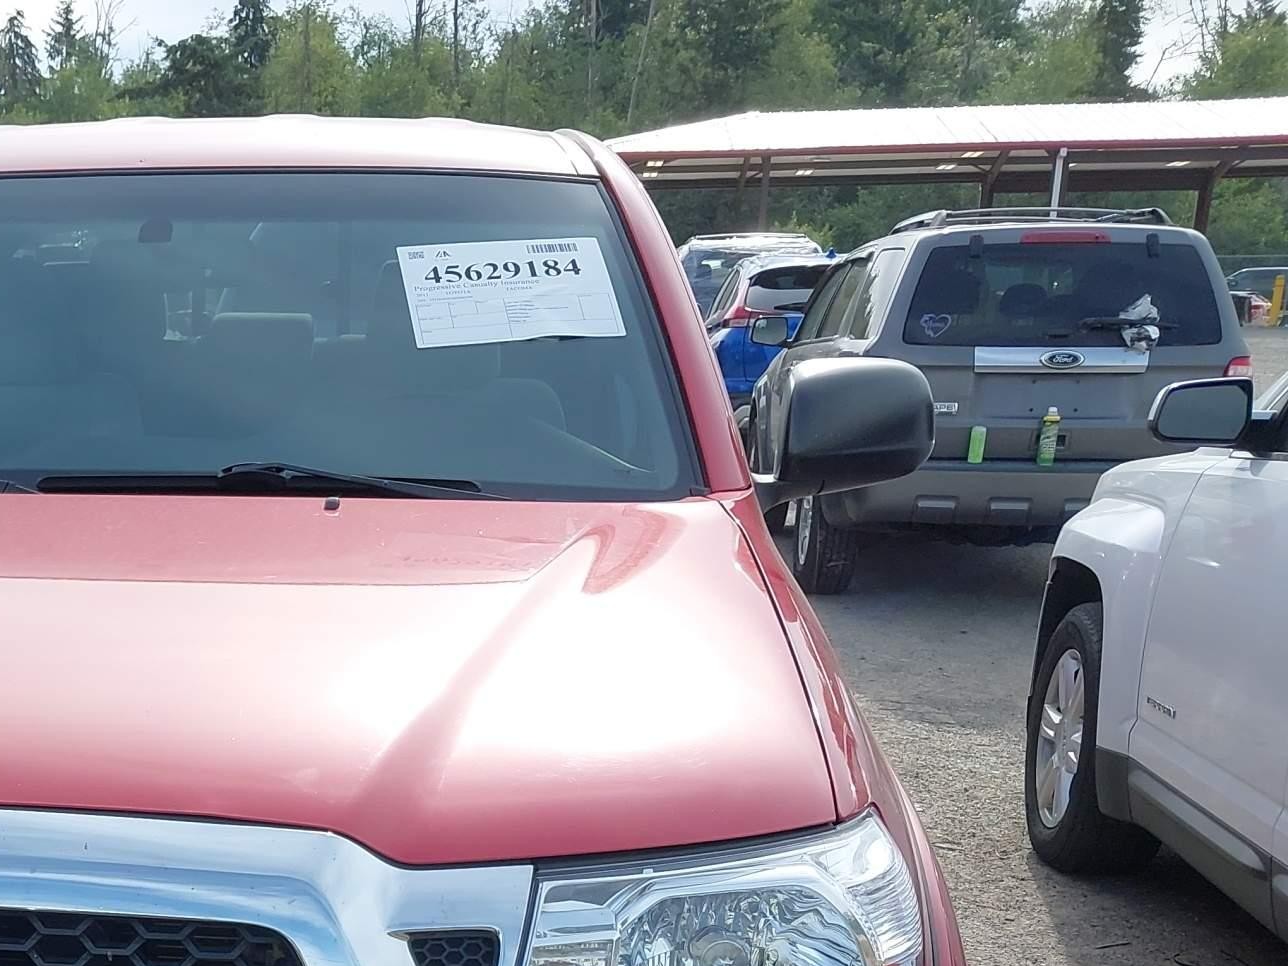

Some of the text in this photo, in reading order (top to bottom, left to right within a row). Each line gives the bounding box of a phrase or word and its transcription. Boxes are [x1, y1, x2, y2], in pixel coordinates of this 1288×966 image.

[424, 258, 582, 284] 45629184
[414, 279, 541, 293] Progressive Casualty Insurance
